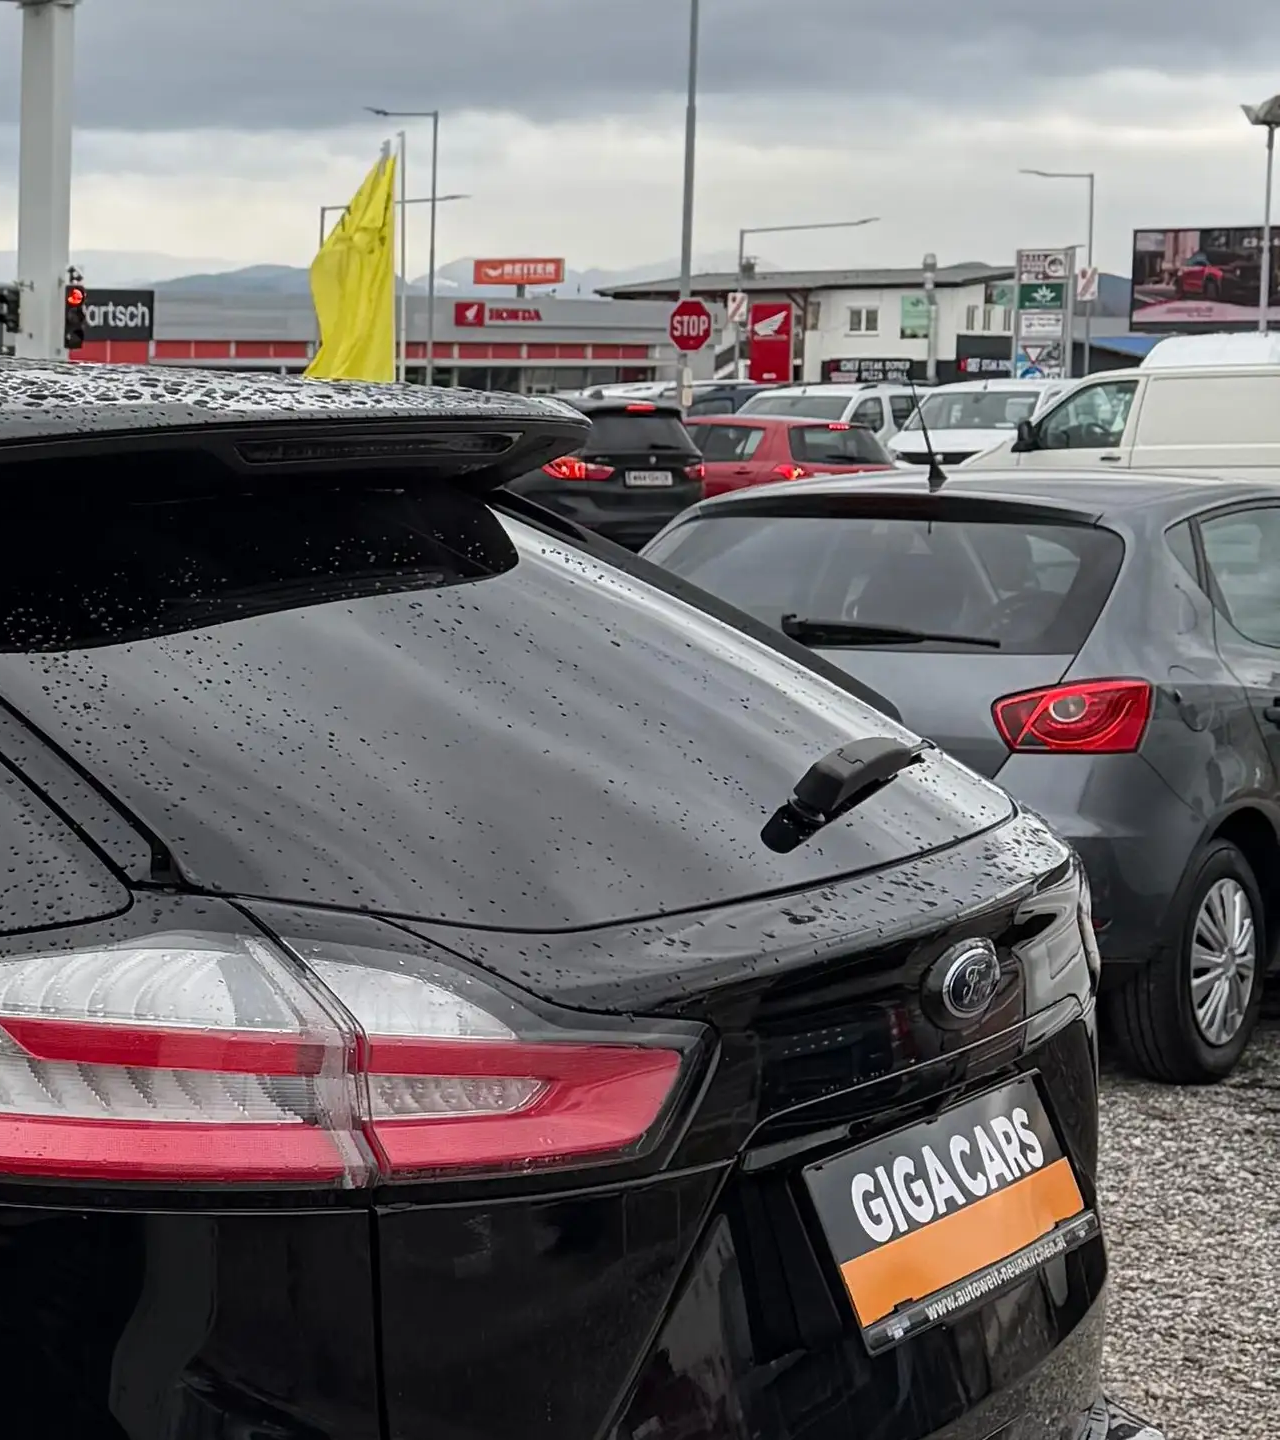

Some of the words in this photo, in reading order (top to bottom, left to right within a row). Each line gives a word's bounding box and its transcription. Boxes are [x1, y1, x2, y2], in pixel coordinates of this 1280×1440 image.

[503, 263, 556, 276] REITER
[82, 301, 150, 328] artsch
[488, 308, 543, 321] HONDA
[672, 315, 709, 337] STOP
